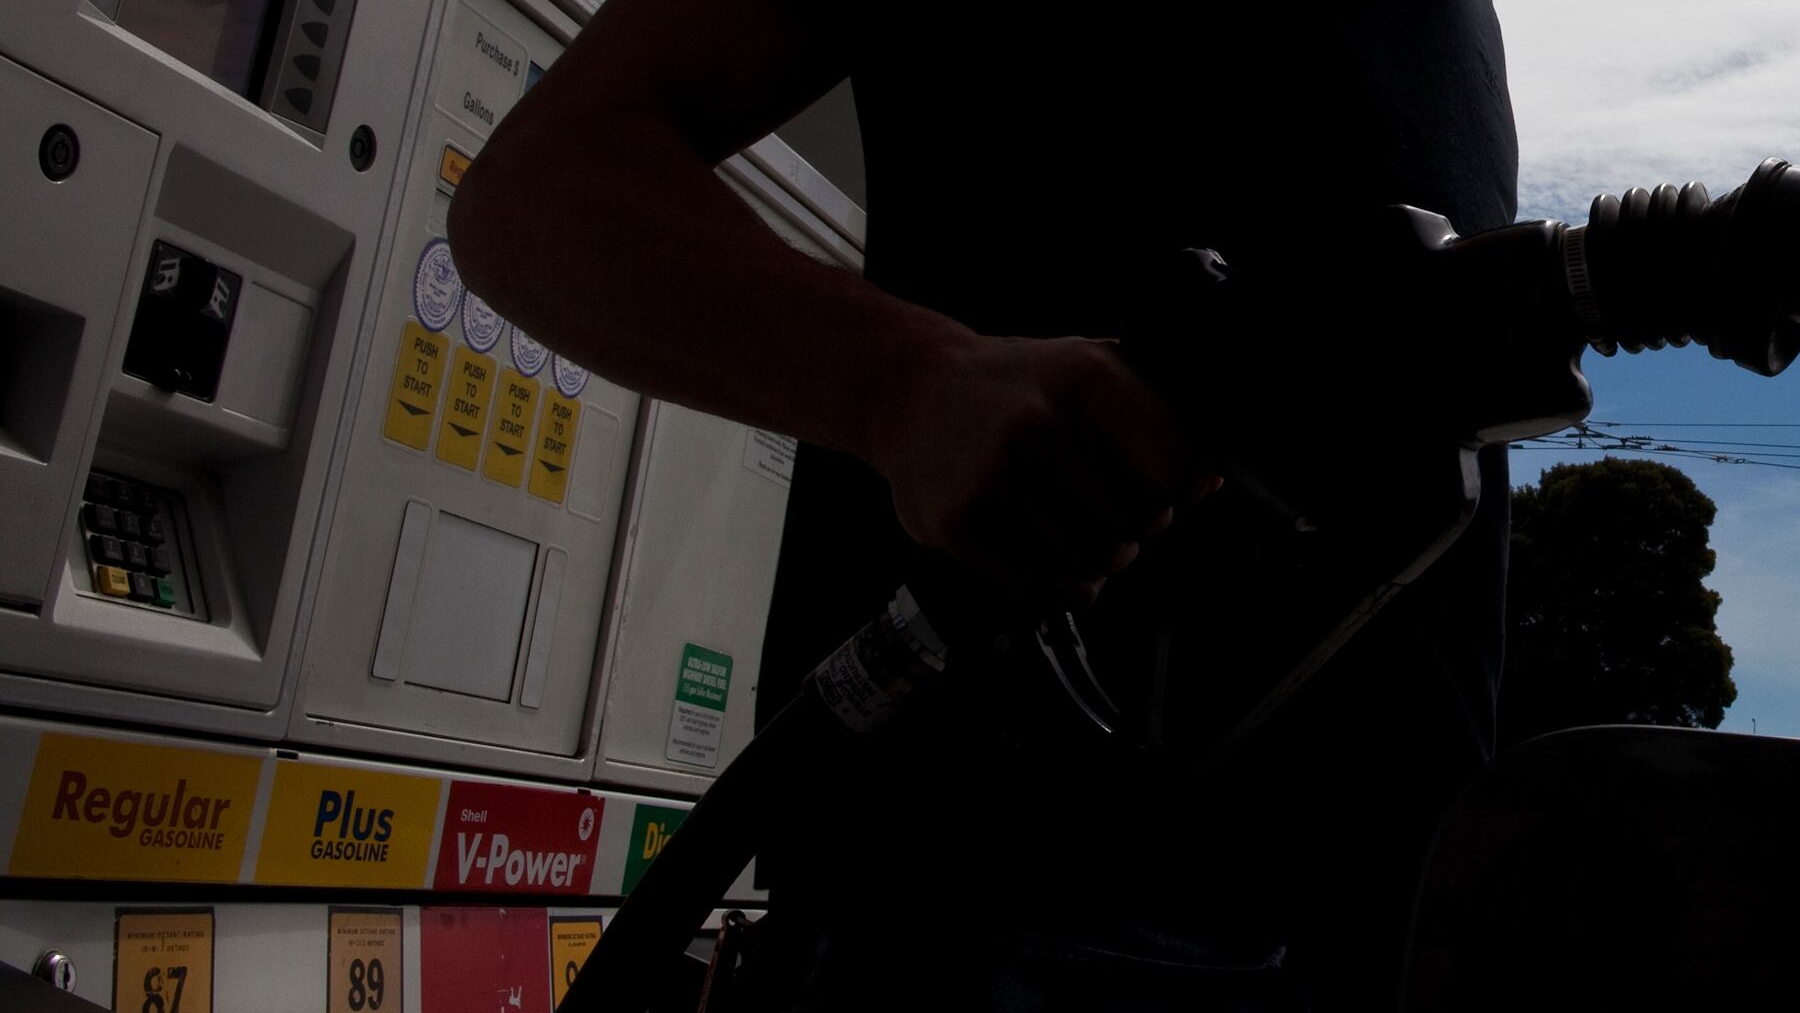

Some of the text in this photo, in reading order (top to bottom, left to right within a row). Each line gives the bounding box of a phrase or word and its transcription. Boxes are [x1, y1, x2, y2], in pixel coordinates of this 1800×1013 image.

[475, 32, 520, 76] Purchase $
[463, 91, 494, 126] Gallons
[414, 337, 439, 359] PUSH
[416, 358, 429, 375] TO
[463, 361, 487, 382] PUSH
[403, 375, 432, 398] START
[466, 382, 477, 398] TO
[509, 383, 531, 403] PUSH
[454, 398, 481, 420] START
[511, 403, 522, 419] TO
[552, 402, 573, 421] PUSH
[500, 418, 525, 439] START
[554, 421, 564, 437] TO
[544, 437, 567, 456] START
[52, 771, 231, 837] Regular
[314, 790, 394, 842] Plus
[460, 808, 488, 823] Shell
[139, 829, 225, 850] GASOLINE
[311, 840, 389, 862] GASOLINE
[142, 966, 188, 1013] 87
[348, 958, 384, 1011] 89
